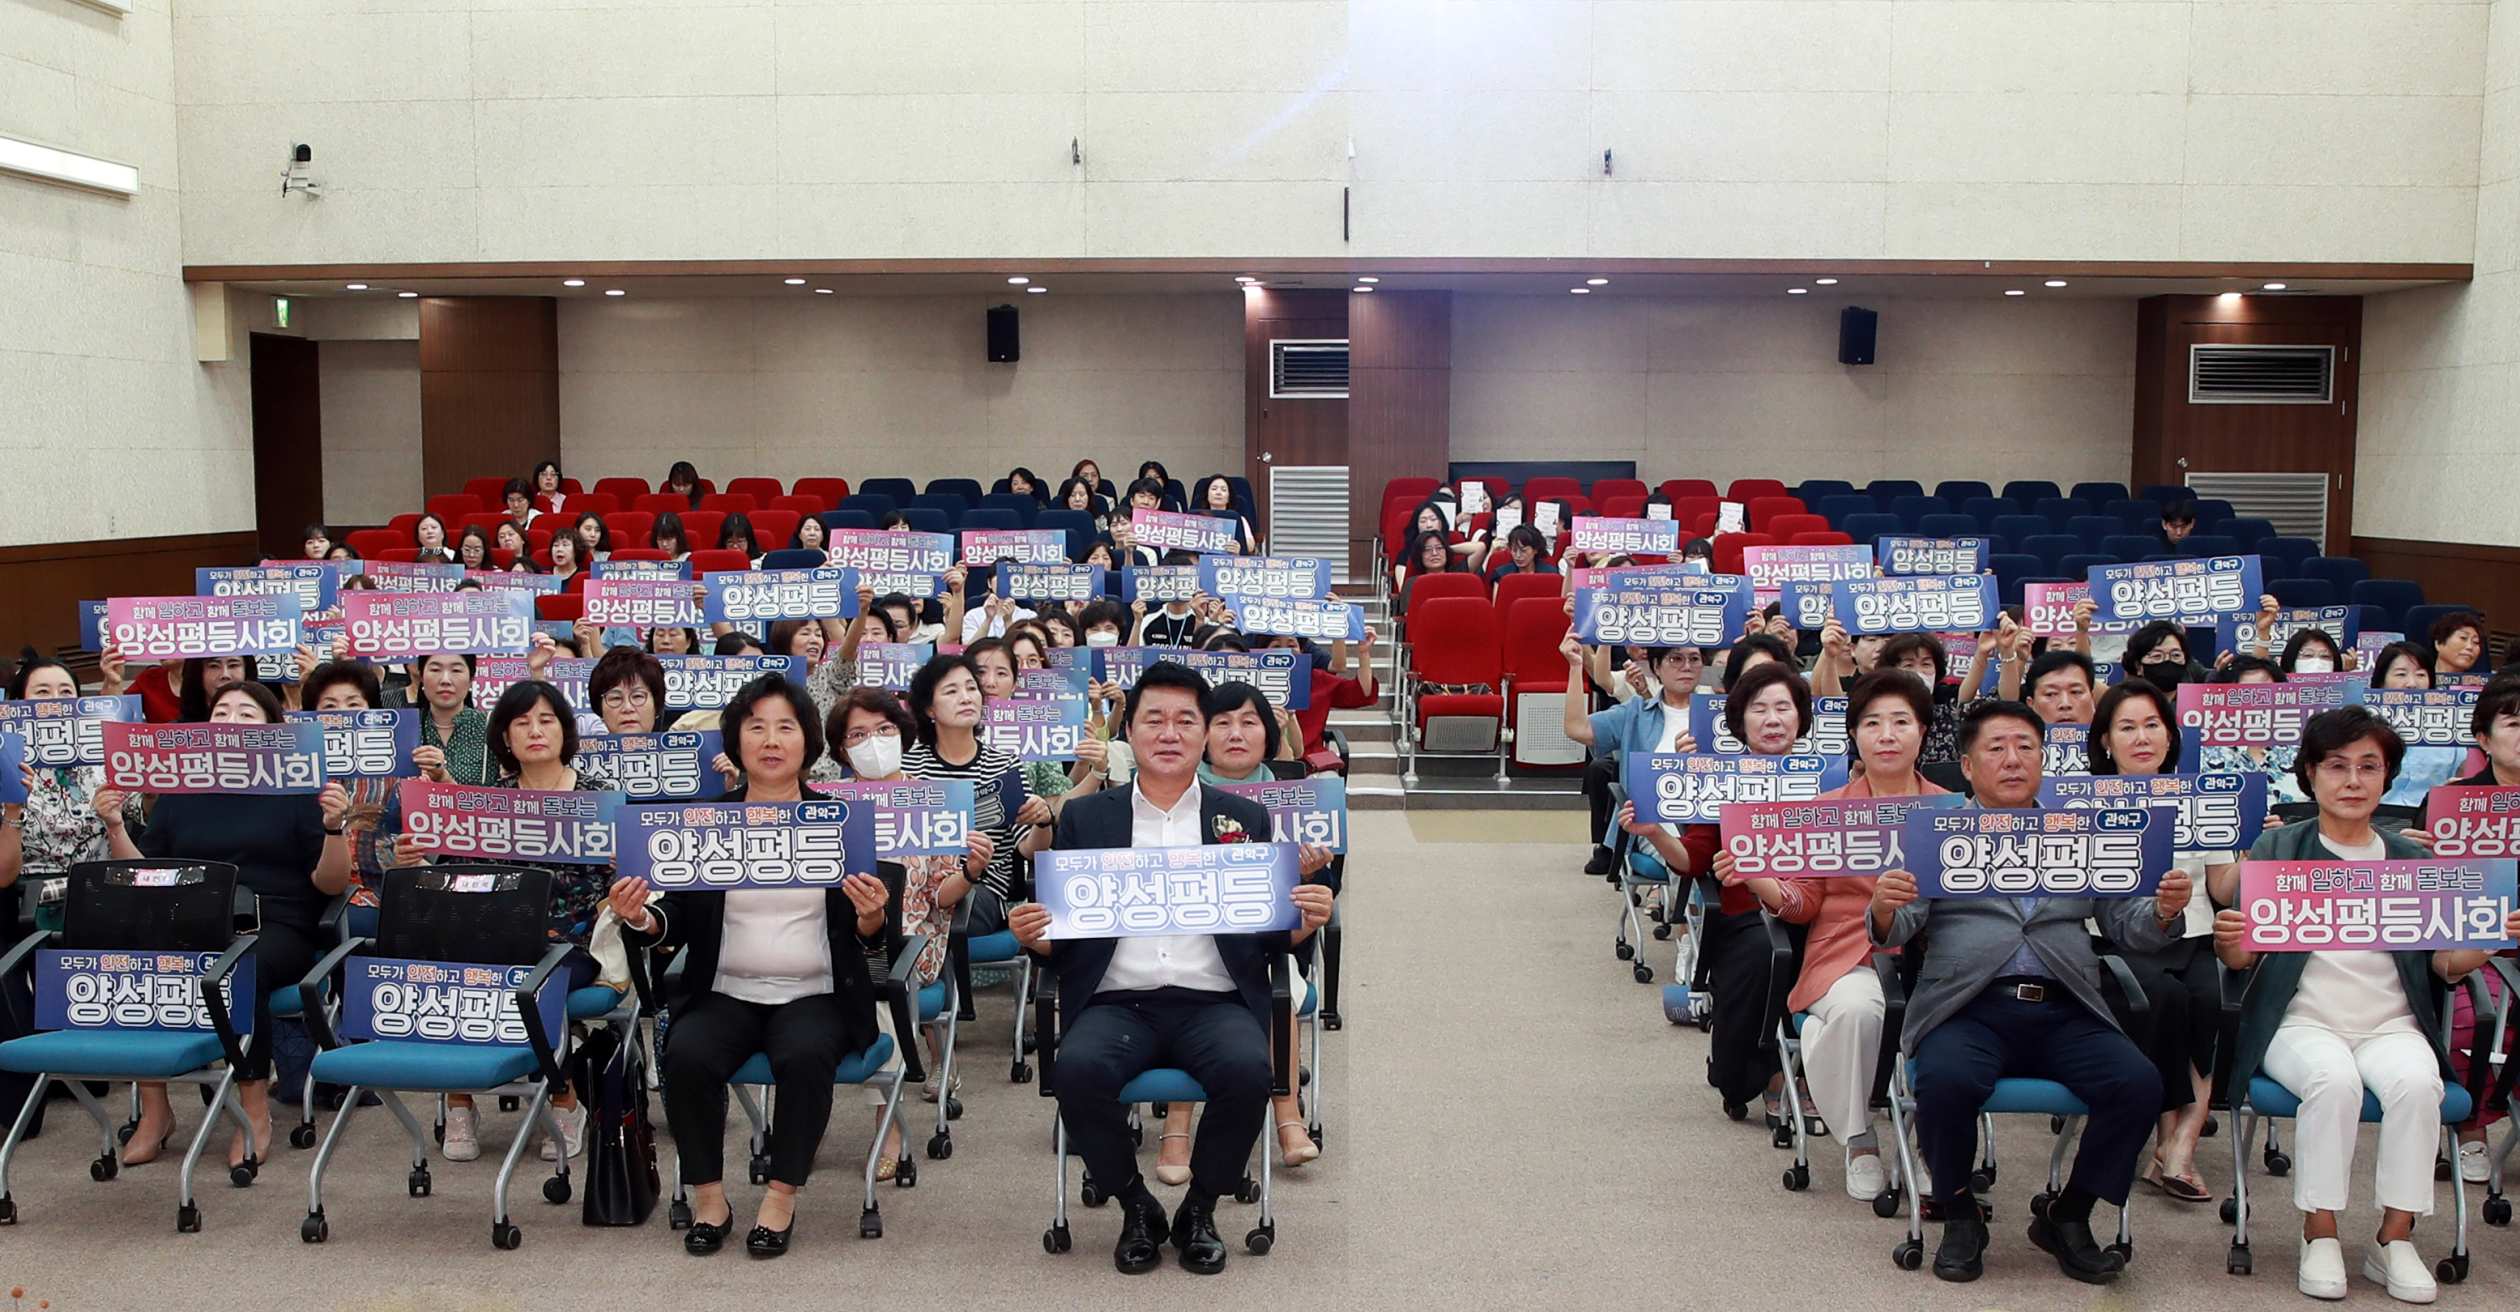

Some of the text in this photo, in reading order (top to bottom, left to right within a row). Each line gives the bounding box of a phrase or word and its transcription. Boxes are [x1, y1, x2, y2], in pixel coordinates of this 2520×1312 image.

[1134, 523, 1233, 550] 양성평등사회
[1575, 530, 1674, 551] 양성평등사회
[830, 545, 950, 574] 양성평등사회
[1892, 548, 1978, 574] 양성평등
[2105, 568, 2132, 579] 모두가
[2213, 559, 2238, 571] 관악구
[1009, 574, 1093, 599] 양성평등
[1215, 567, 1317, 598] 양성평등
[1848, 582, 1875, 592] 모두가
[368, 595, 512, 616] 함께 일하고 함께 돌보는
[722, 581, 841, 619] 양성평등
[2111, 573, 2244, 619] 양성평등
[133, 599, 278, 618] 함께 일하고 함께 돌보는
[1855, 591, 1984, 631] 양성평등
[352, 615, 530, 652] 양성평등사회
[1243, 605, 1351, 638] 양성평등
[1596, 604, 1724, 646] 양성평등
[115, 618, 298, 656] 양성평등사회
[1266, 655, 1290, 666] 관악구
[2202, 686, 2344, 705] 함께 일하고 함께 돌보는
[364, 712, 392, 725] 관악구
[993, 704, 1062, 722] 함께 돌보는
[128, 728, 297, 750] 함께 일하고 함께 돌보는
[667, 733, 697, 746] 관악구
[111, 750, 319, 790] 양성평등사회
[1651, 758, 1684, 771] 모두가
[1788, 758, 1819, 770] 관악구
[890, 785, 945, 808] 돌보는
[1261, 786, 1316, 807] 돌보는
[2055, 777, 2237, 797] 모두가 안전하고 행복한 관악구
[428, 791, 598, 817] 함께 일하고 함께 돌보는
[640, 805, 840, 827] 모두가 안전하고 행복한 관악구
[2459, 796, 2487, 813] 함께
[1751, 812, 1779, 829] 함께
[1781, 806, 1839, 829] 일하고
[1844, 809, 1873, 825] 함께
[1933, 812, 2141, 832] 모두가 안전하고 행복한 관악구
[408, 810, 616, 858] 양성평등사회
[648, 825, 845, 886] 양성평등
[1055, 855, 1097, 872] 모두가
[1102, 851, 1163, 871] 안전하고
[1231, 847, 1269, 862] 관악구
[1939, 831, 2142, 893] 양성평등
[2275, 866, 2483, 892] 함께 일하고 함께 돌보는
[1064, 864, 1277, 933] 양성평등
[2250, 895, 2508, 944] 양성평등사회
[60, 956, 97, 971] 모두가
[100, 954, 153, 972] 안전하고
[157, 955, 194, 973] 행복한
[368, 964, 404, 979] 모두가
[407, 964, 460, 983] 안전하고
[463, 967, 502, 986] 행복한
